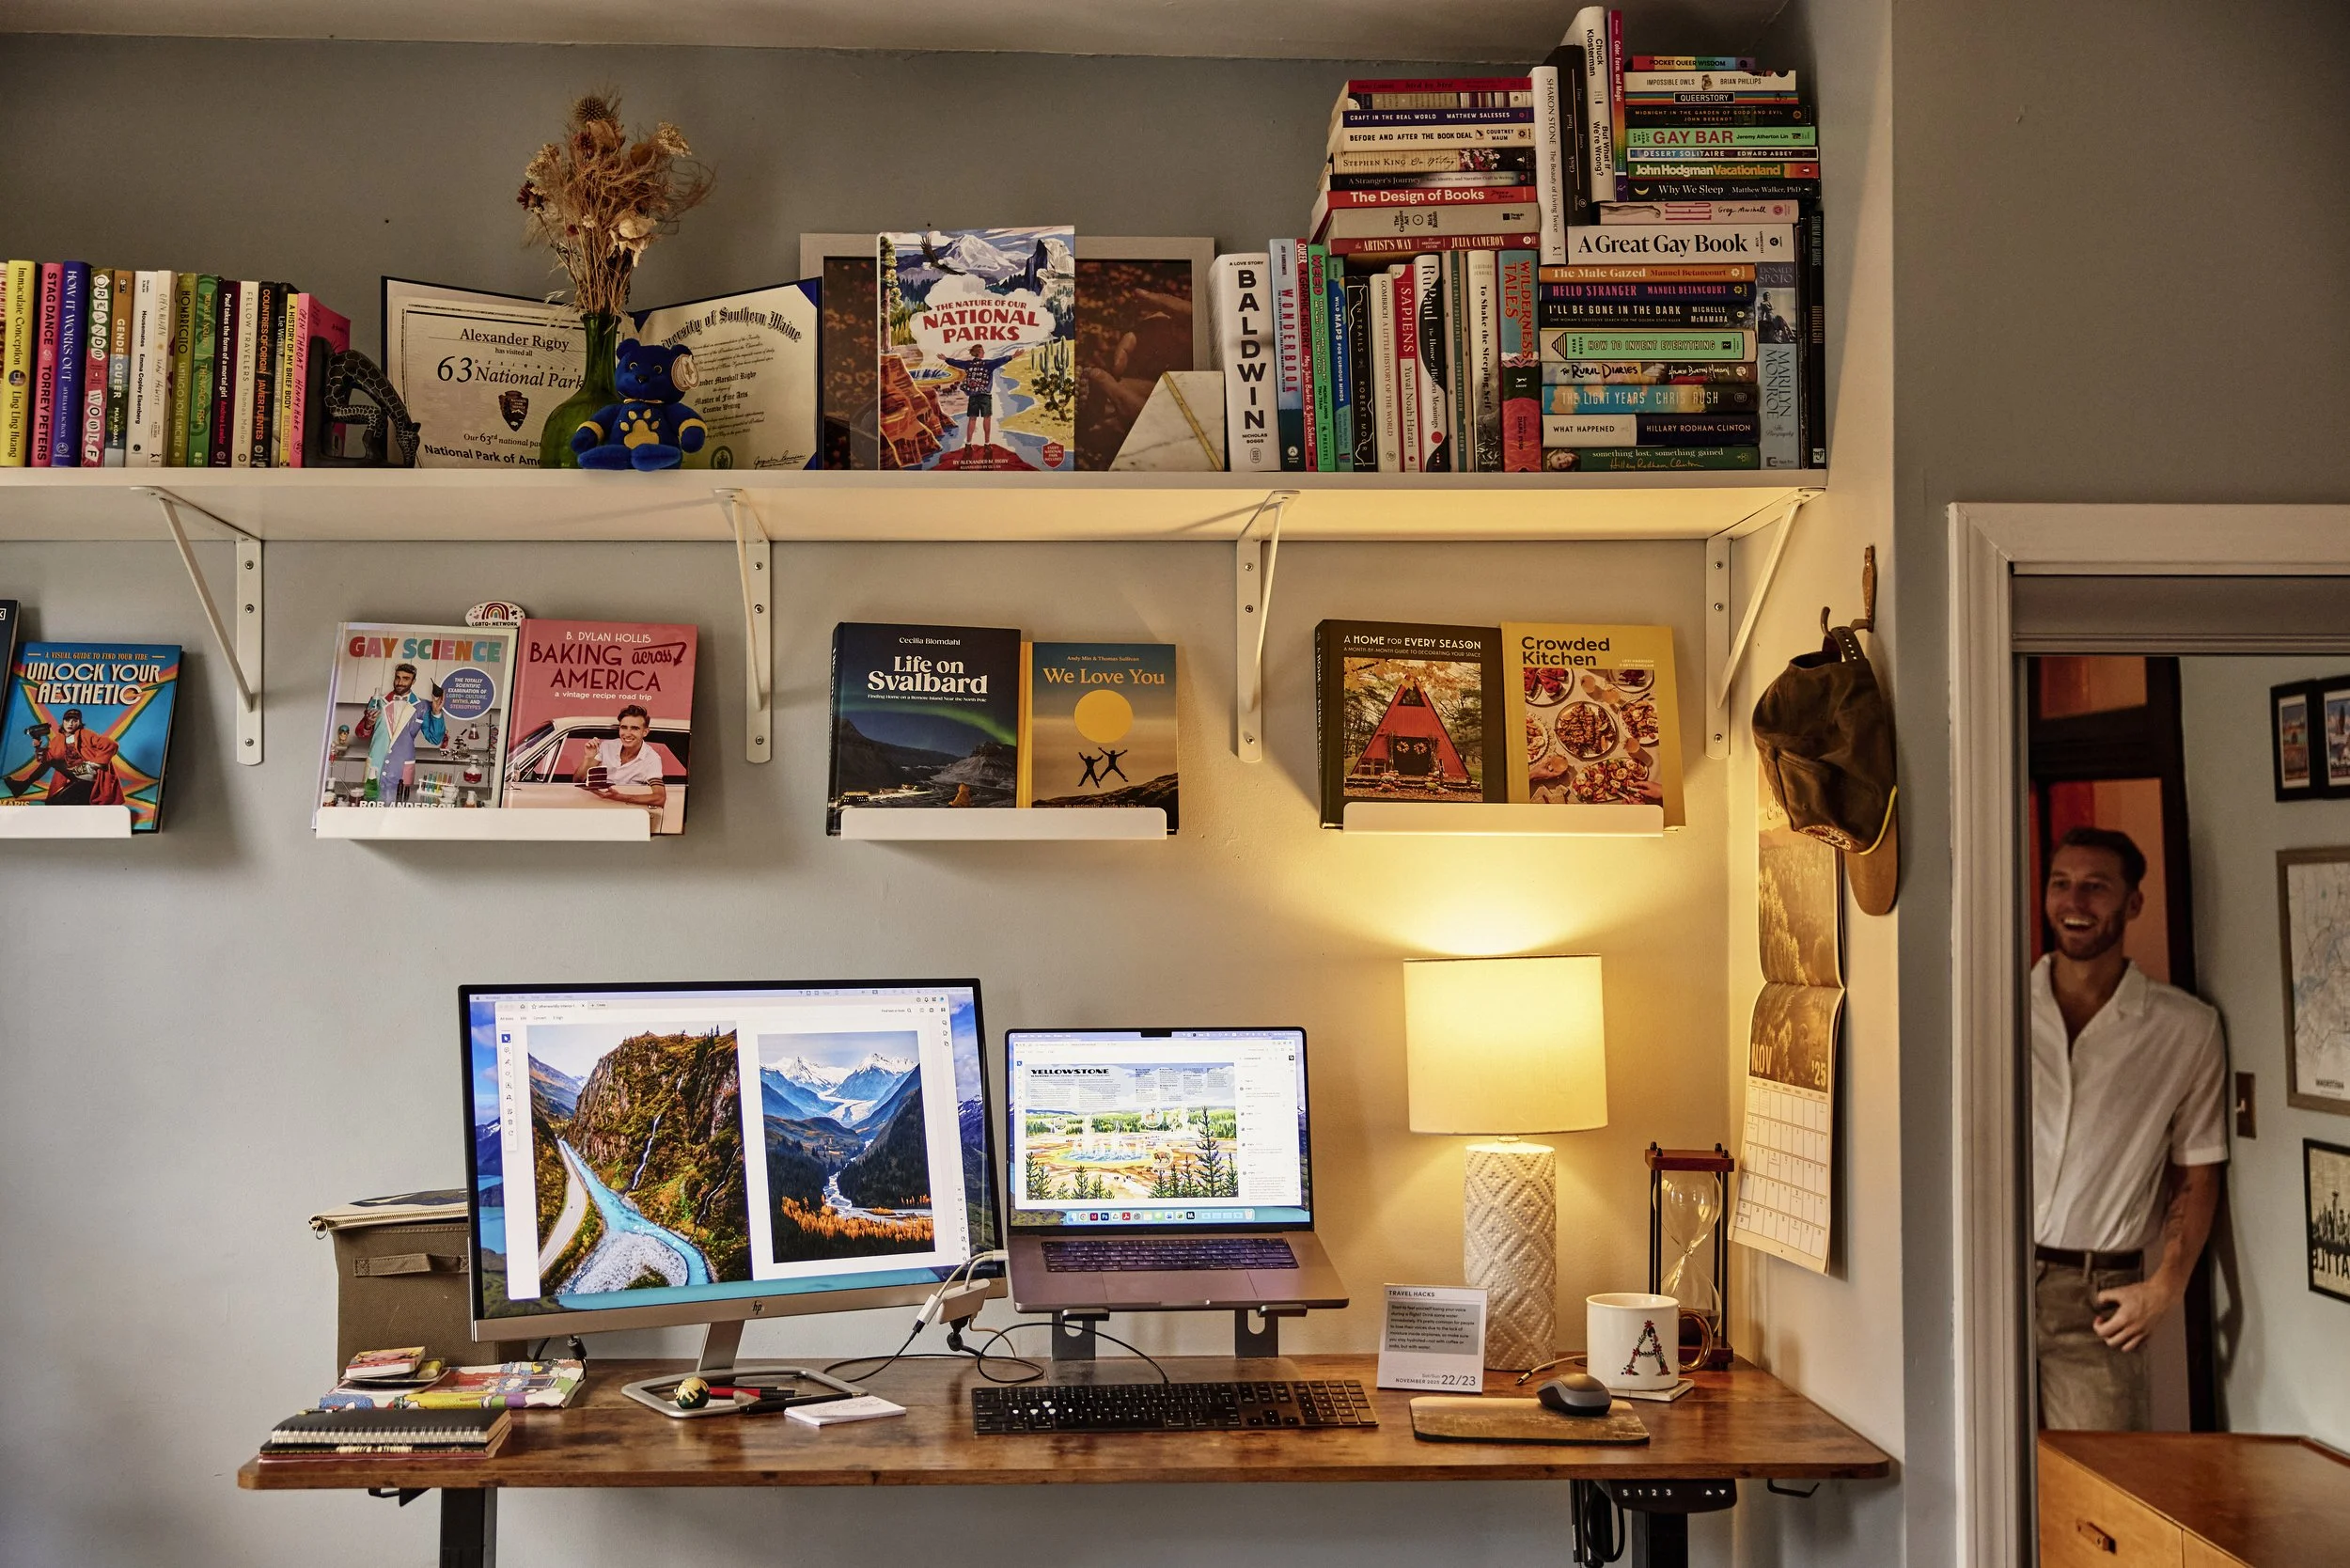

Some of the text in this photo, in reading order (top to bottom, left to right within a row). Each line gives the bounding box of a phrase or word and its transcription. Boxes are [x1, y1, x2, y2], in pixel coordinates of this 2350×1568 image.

[1587, 29, 1595, 76] Klosterman
[1546, 79, 1557, 144] SHARON STONE
[1653, 131, 1689, 144] GAY
[1696, 131, 1733, 142] BAR
[1595, 149, 1604, 176] Wrong?
[1350, 192, 1377, 203] The
[1380, 191, 1423, 204] Design
[1428, 190, 1441, 200] of
[1445, 189, 1484, 199] Books
[1659, 185, 1724, 195] Why We Sleep
[1298, 243, 1308, 263] QUEER
[1364, 239, 1395, 251] ARTIST'S
[1397, 239, 1412, 250] WAY
[1450, 237, 1470, 248] JULIA
[1472, 235, 1504, 247] CAMERON
[1578, 234, 1747, 257] A Great Gay Book
[1311, 255, 1324, 295] WEED
[1552, 268, 1645, 278] The Male Gazed
[1422, 265, 1437, 320] RuPaul
[1504, 263, 1518, 319] TALES
[1553, 286, 1637, 296] HELLO STRANGER
[14, 267, 27, 366] Immaculate Conception
[44, 272, 56, 344] STAG DANCE
[935, 302, 954, 311] THE
[956, 300, 993, 308] NATURE
[1009, 300, 1026, 308] OUR
[1518, 260, 1533, 359] WILDERNESS
[1549, 306, 1681, 315] I'LL BE GONE IN THE DARK
[62, 271, 77, 382] HOW IT WORKS OUT
[179, 291, 190, 353] HOMBRECITO
[705, 310, 716, 327] of
[718, 306, 766, 324] Southern
[768, 311, 802, 343] Maine
[923, 308, 1040, 330] NATIONAL
[1401, 288, 1414, 353] SAPIENS
[460, 329, 570, 352] Alexander Rigby
[943, 325, 1020, 344] PARKS
[1282, 289, 1298, 392] WONDERBOOK
[114, 319, 125, 399] GENDER QUEER
[1237, 270, 1266, 429] BALDWIN
[437, 356, 585, 390] 63 National Park
[1765, 350, 1779, 419] MONROE
[1777, 352, 1791, 417] MARILYN
[38, 366, 52, 460] TORREY PETERS
[424, 444, 515, 463] National Park of
[349, 636, 502, 662] GAY SCIENCE
[579, 633, 611, 641] DYLAN
[616, 634, 650, 643] HOLLIS
[1344, 635, 1351, 644] A
[1354, 635, 1385, 645] HOME
[1405, 638, 1435, 648] EVERY
[1439, 639, 1481, 650] SEASON
[1522, 636, 1610, 651] Crowded
[530, 642, 672, 666] BAKING across
[894, 656, 964, 673] Life on
[1522, 651, 1597, 666] Kitchen
[26, 663, 160, 682] UNLOCK YOUR
[551, 667, 661, 691] AMERICA
[868, 671, 987, 694] Svalbard
[1042, 668, 1166, 684] We Love You
[38, 683, 143, 705] AESTHETIC
[563, 691, 589, 699] vintage
[1752, 1043, 1772, 1074] NOV
[1812, 1060, 1825, 1087] '25
[1621, 1320, 1671, 1376] A
[1442, 1375, 1476, 1386] 22/23
